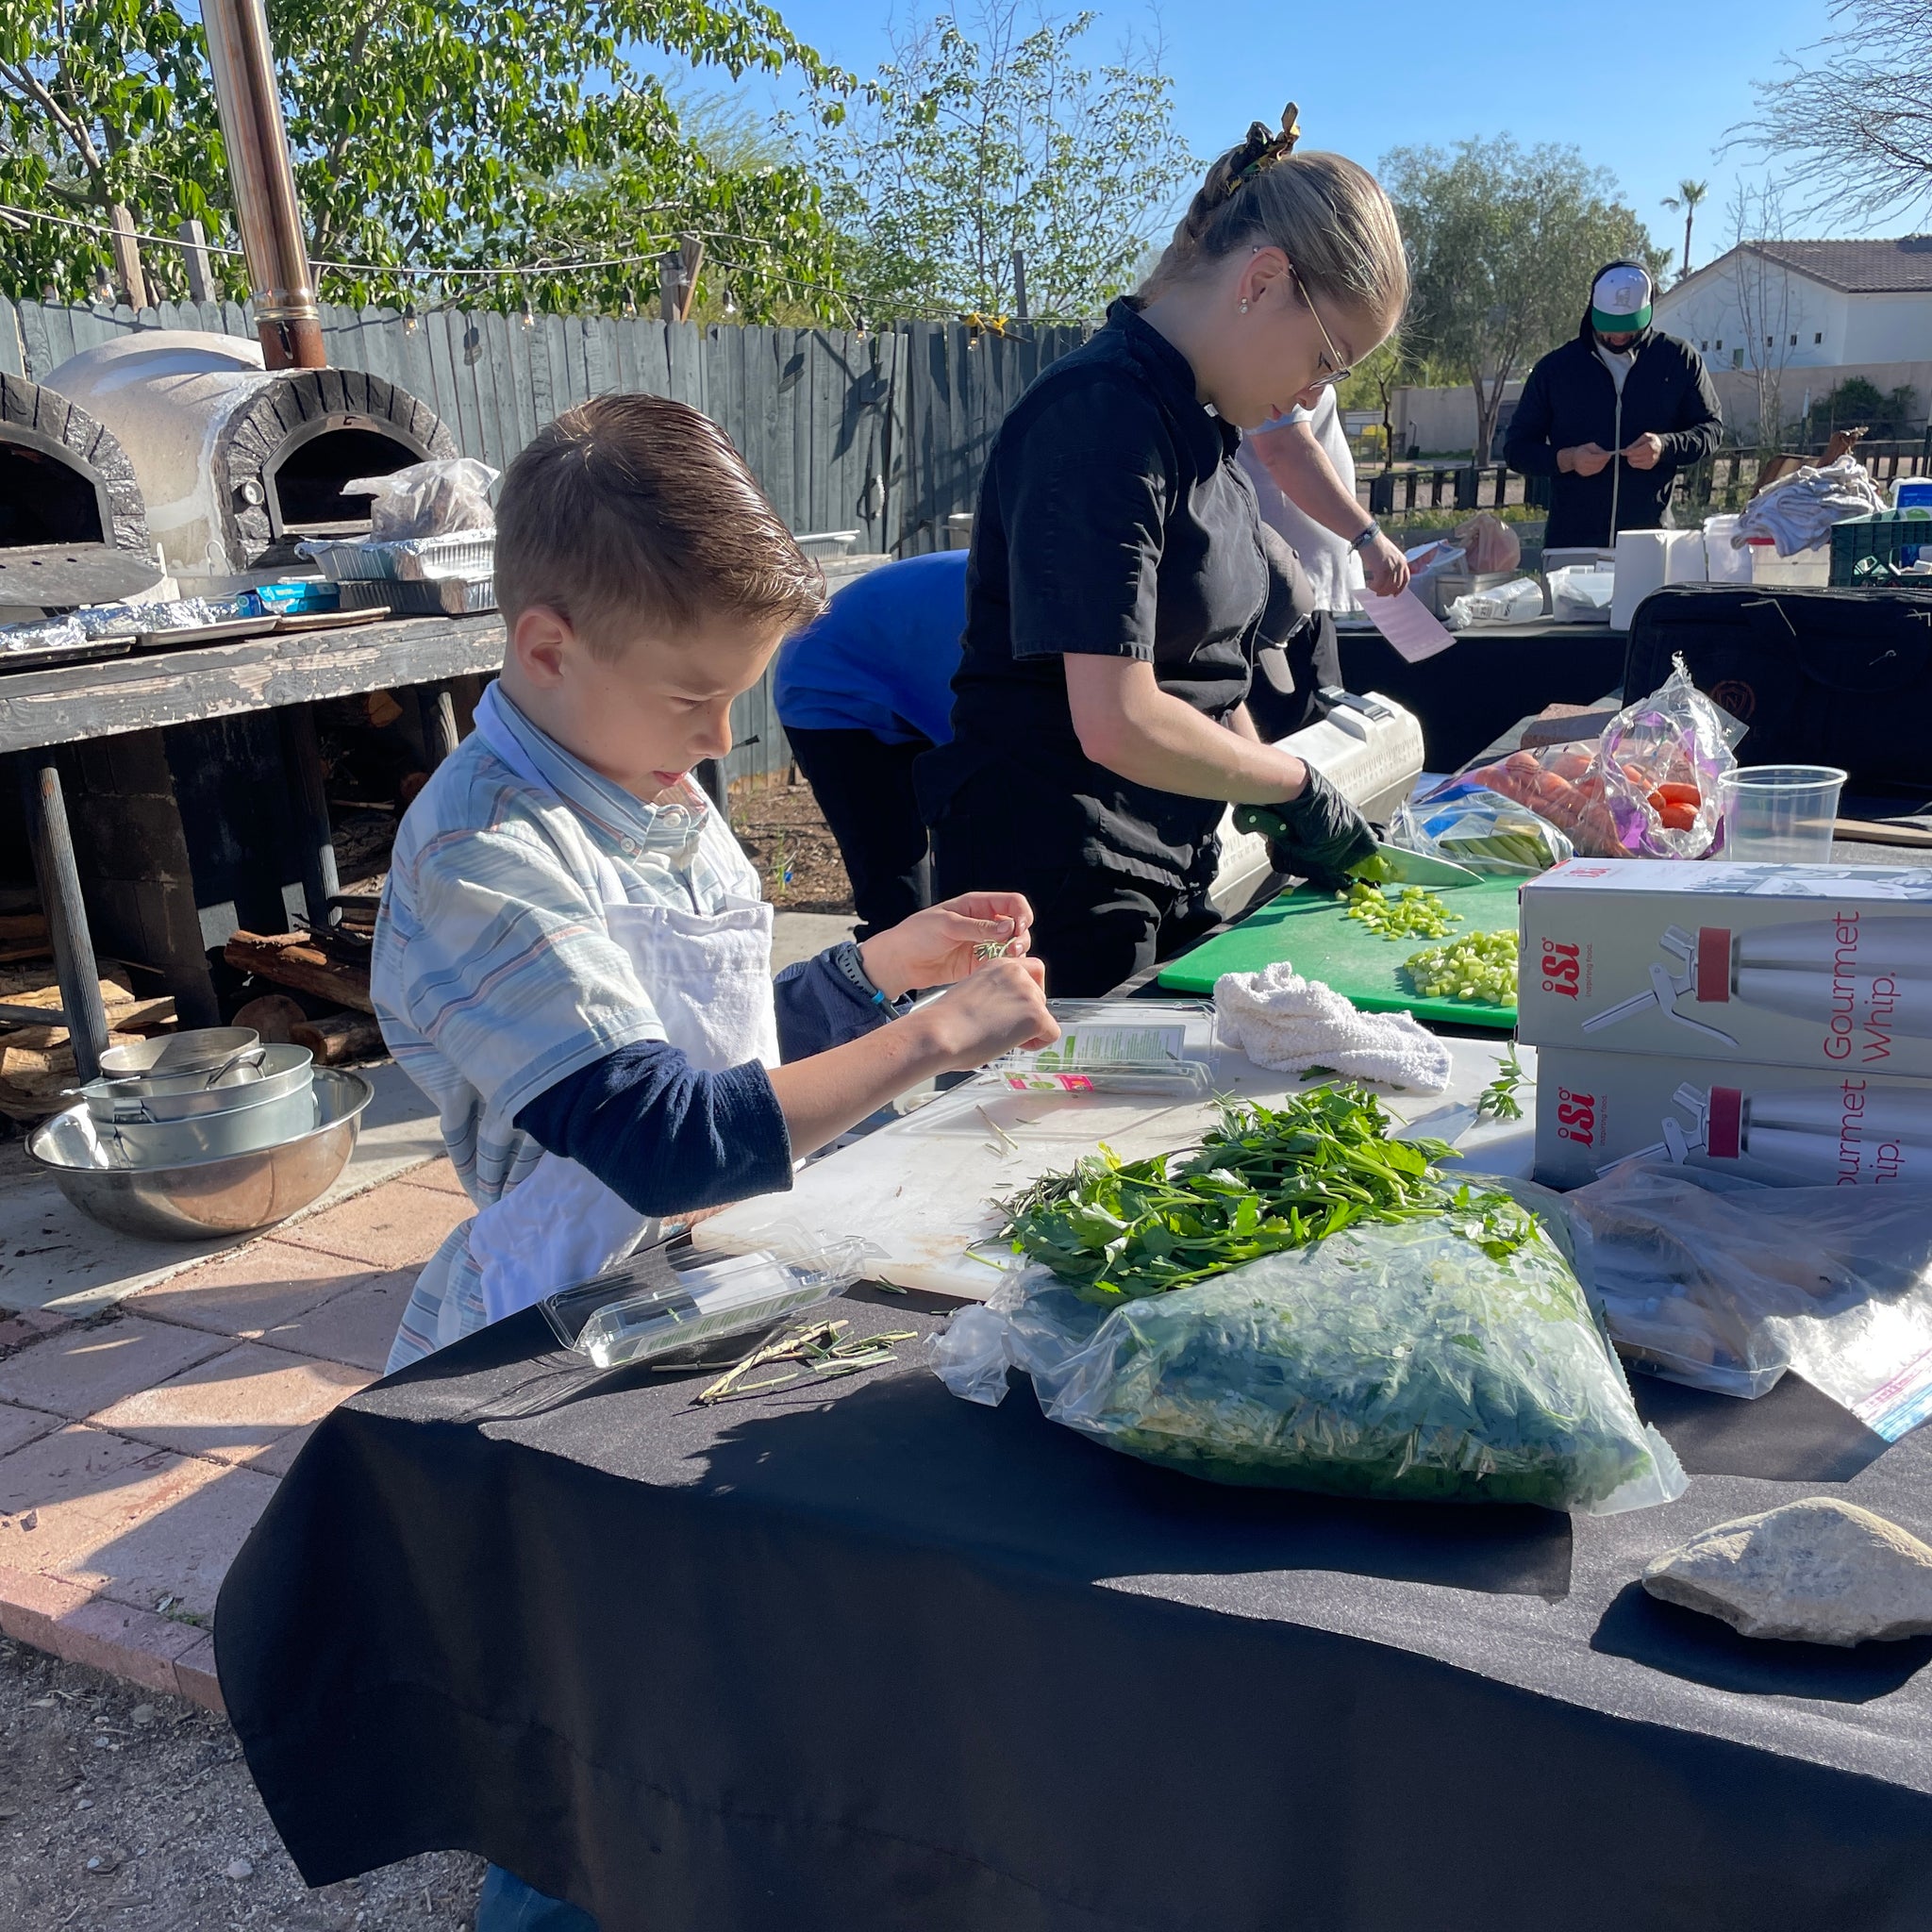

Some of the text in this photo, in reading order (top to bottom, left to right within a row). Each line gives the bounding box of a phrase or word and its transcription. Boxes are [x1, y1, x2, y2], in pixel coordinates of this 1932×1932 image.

[1541, 937, 1580, 1001] iSi
[1586, 962, 1594, 997] inspiring
[1824, 910, 1859, 1059] Gourmet
[1861, 973, 1902, 1062] Whip.
[1557, 1087, 1595, 1149] iSi
